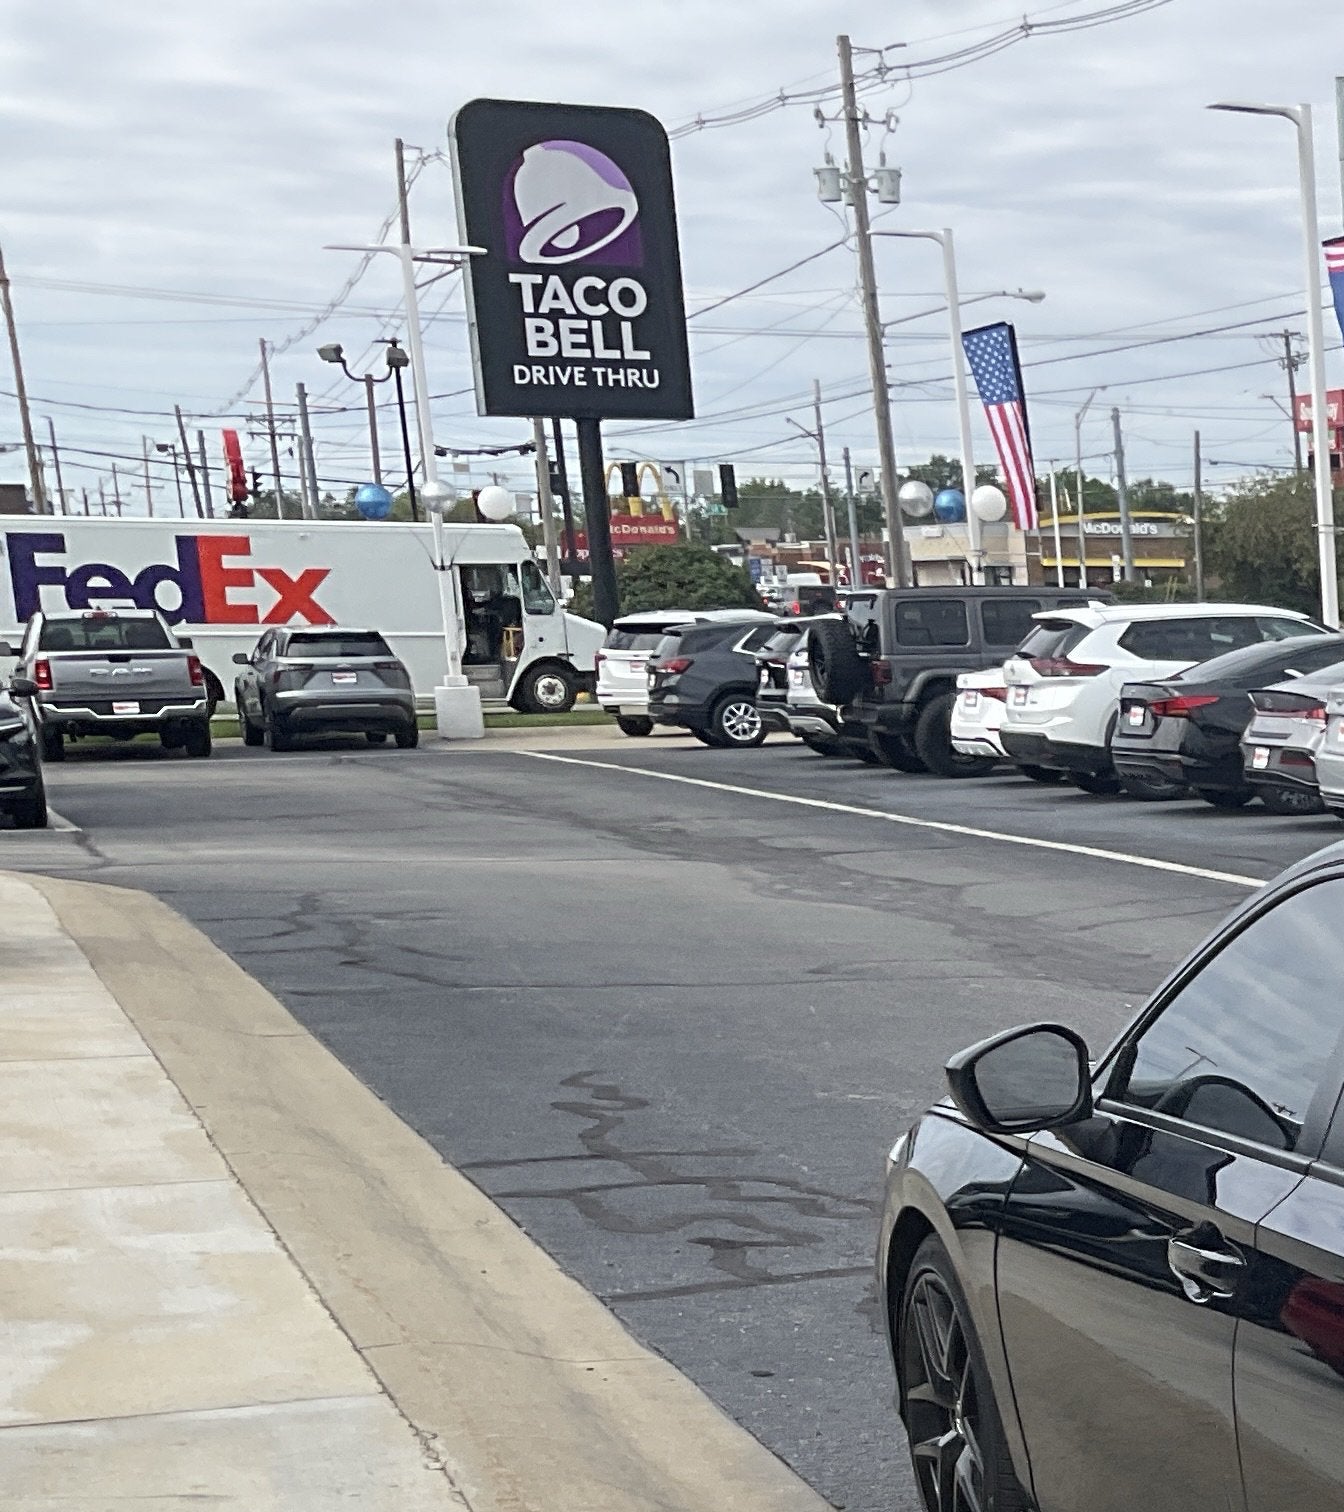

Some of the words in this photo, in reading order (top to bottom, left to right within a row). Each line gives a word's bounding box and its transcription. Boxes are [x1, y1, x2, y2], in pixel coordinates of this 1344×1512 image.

[508, 273, 647, 318] TACO
[525, 317, 651, 360] BELL
[513, 364, 588, 386] DRIVE
[591, 366, 660, 388] THRU
[609, 523, 676, 535] cDonald's
[6, 532, 337, 624] FedEx
